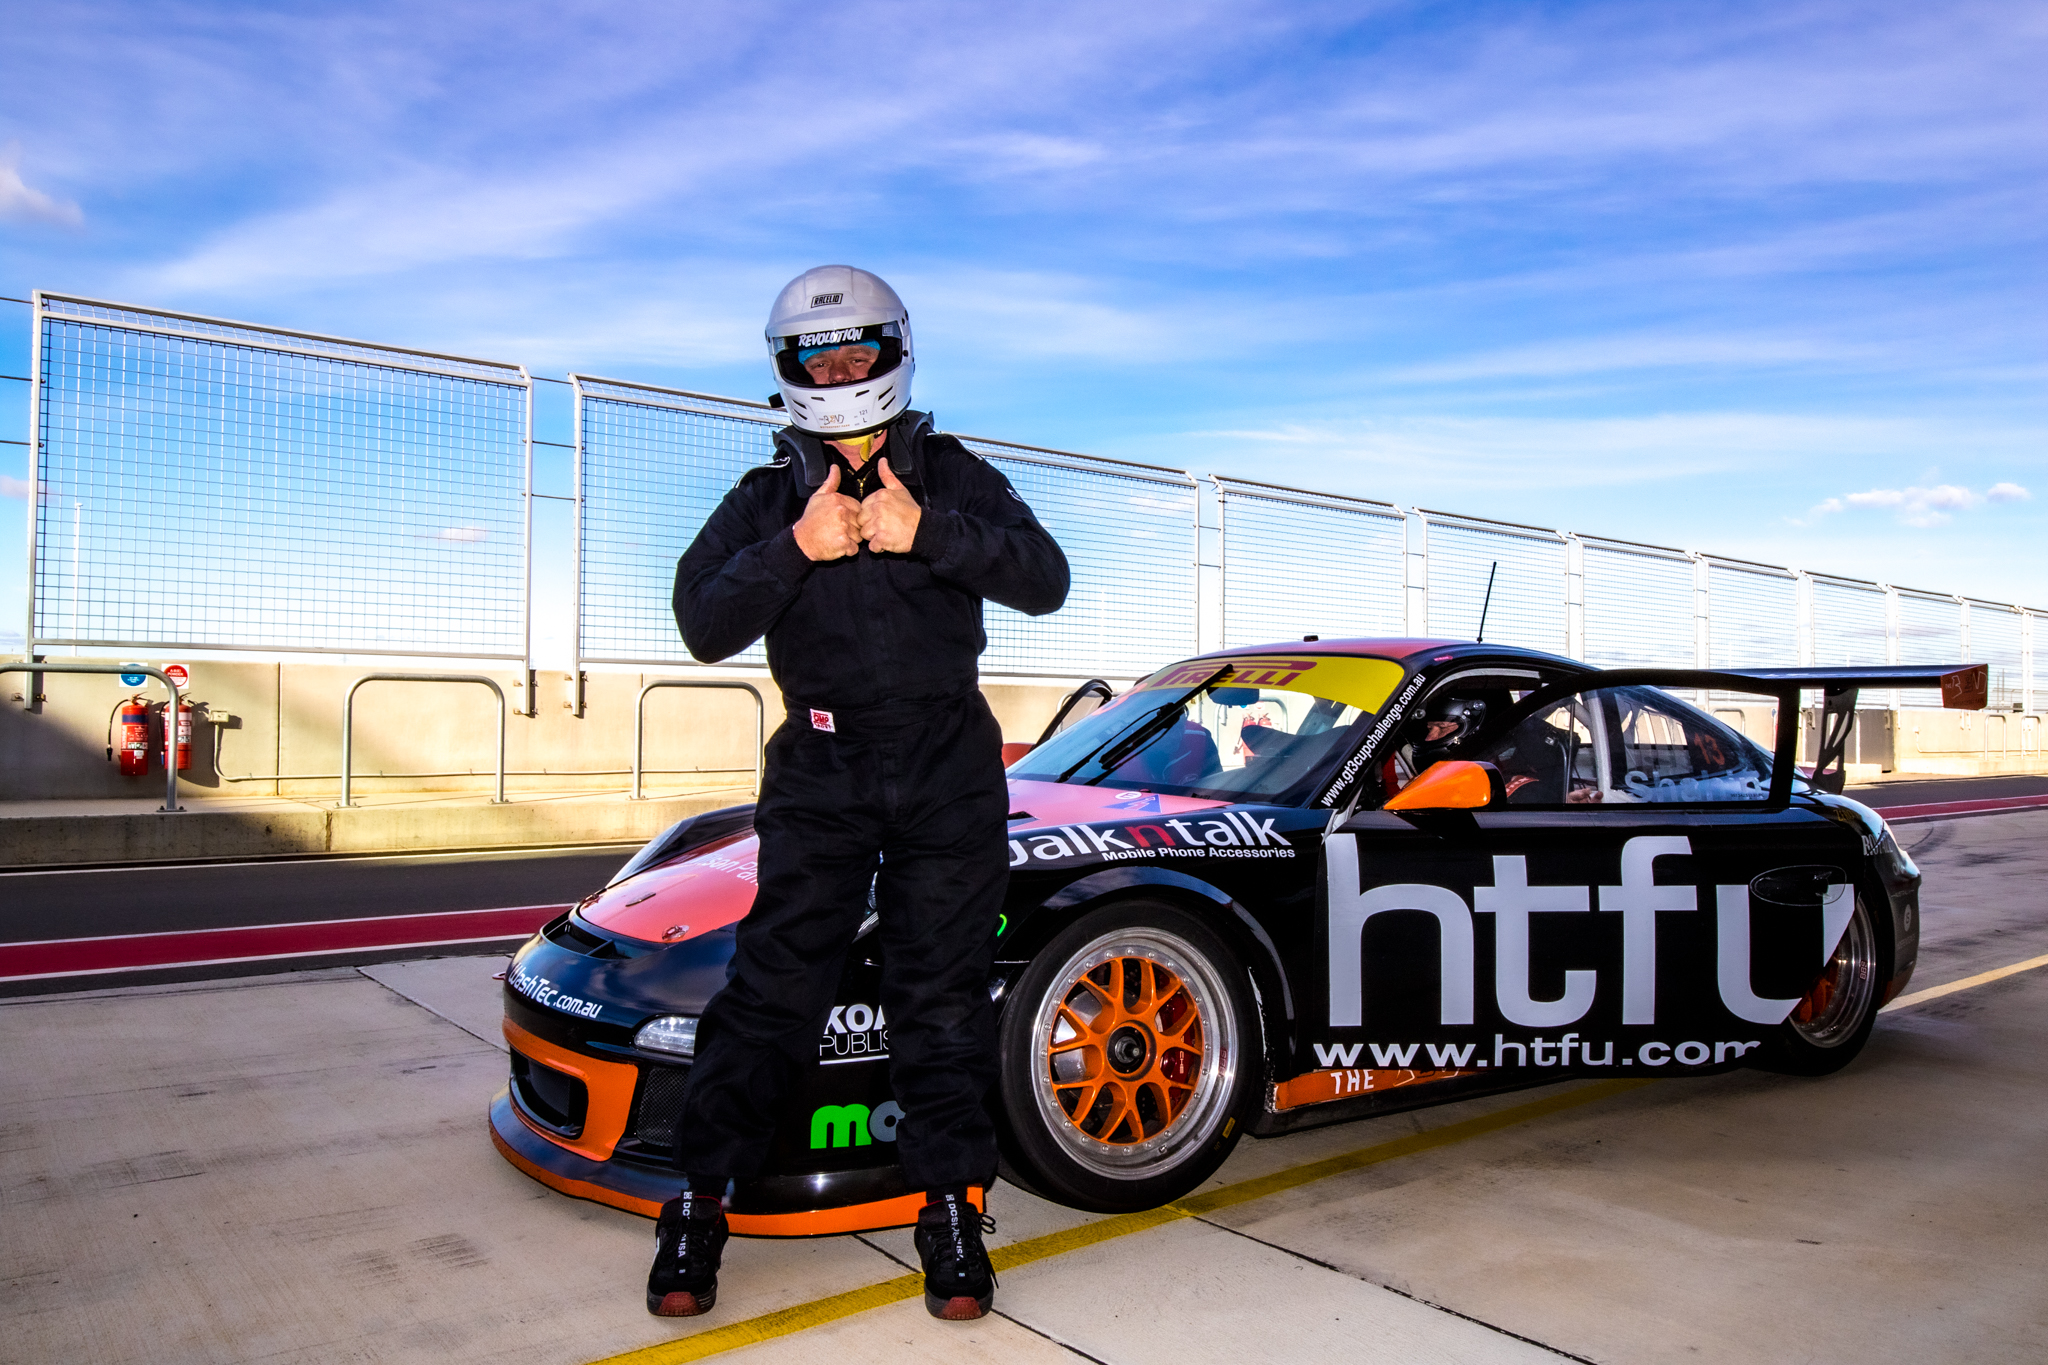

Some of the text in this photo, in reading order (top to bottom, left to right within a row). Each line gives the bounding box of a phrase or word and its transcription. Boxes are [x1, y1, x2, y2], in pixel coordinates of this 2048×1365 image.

[814, 294, 840, 306] RACELID
[798, 327, 864, 348] REVOLUTION
[1150, 660, 1318, 687] PIRELLI
[1319, 673, 1426, 808] www.gt3cupchallenge.com.au
[1101, 846, 1296, 862] Mobile Phone Accessories
[1325, 832, 1856, 1028] htfu
[1312, 1032, 1762, 1069] www.htfu.com
[1330, 1068, 1375, 1095] THE
